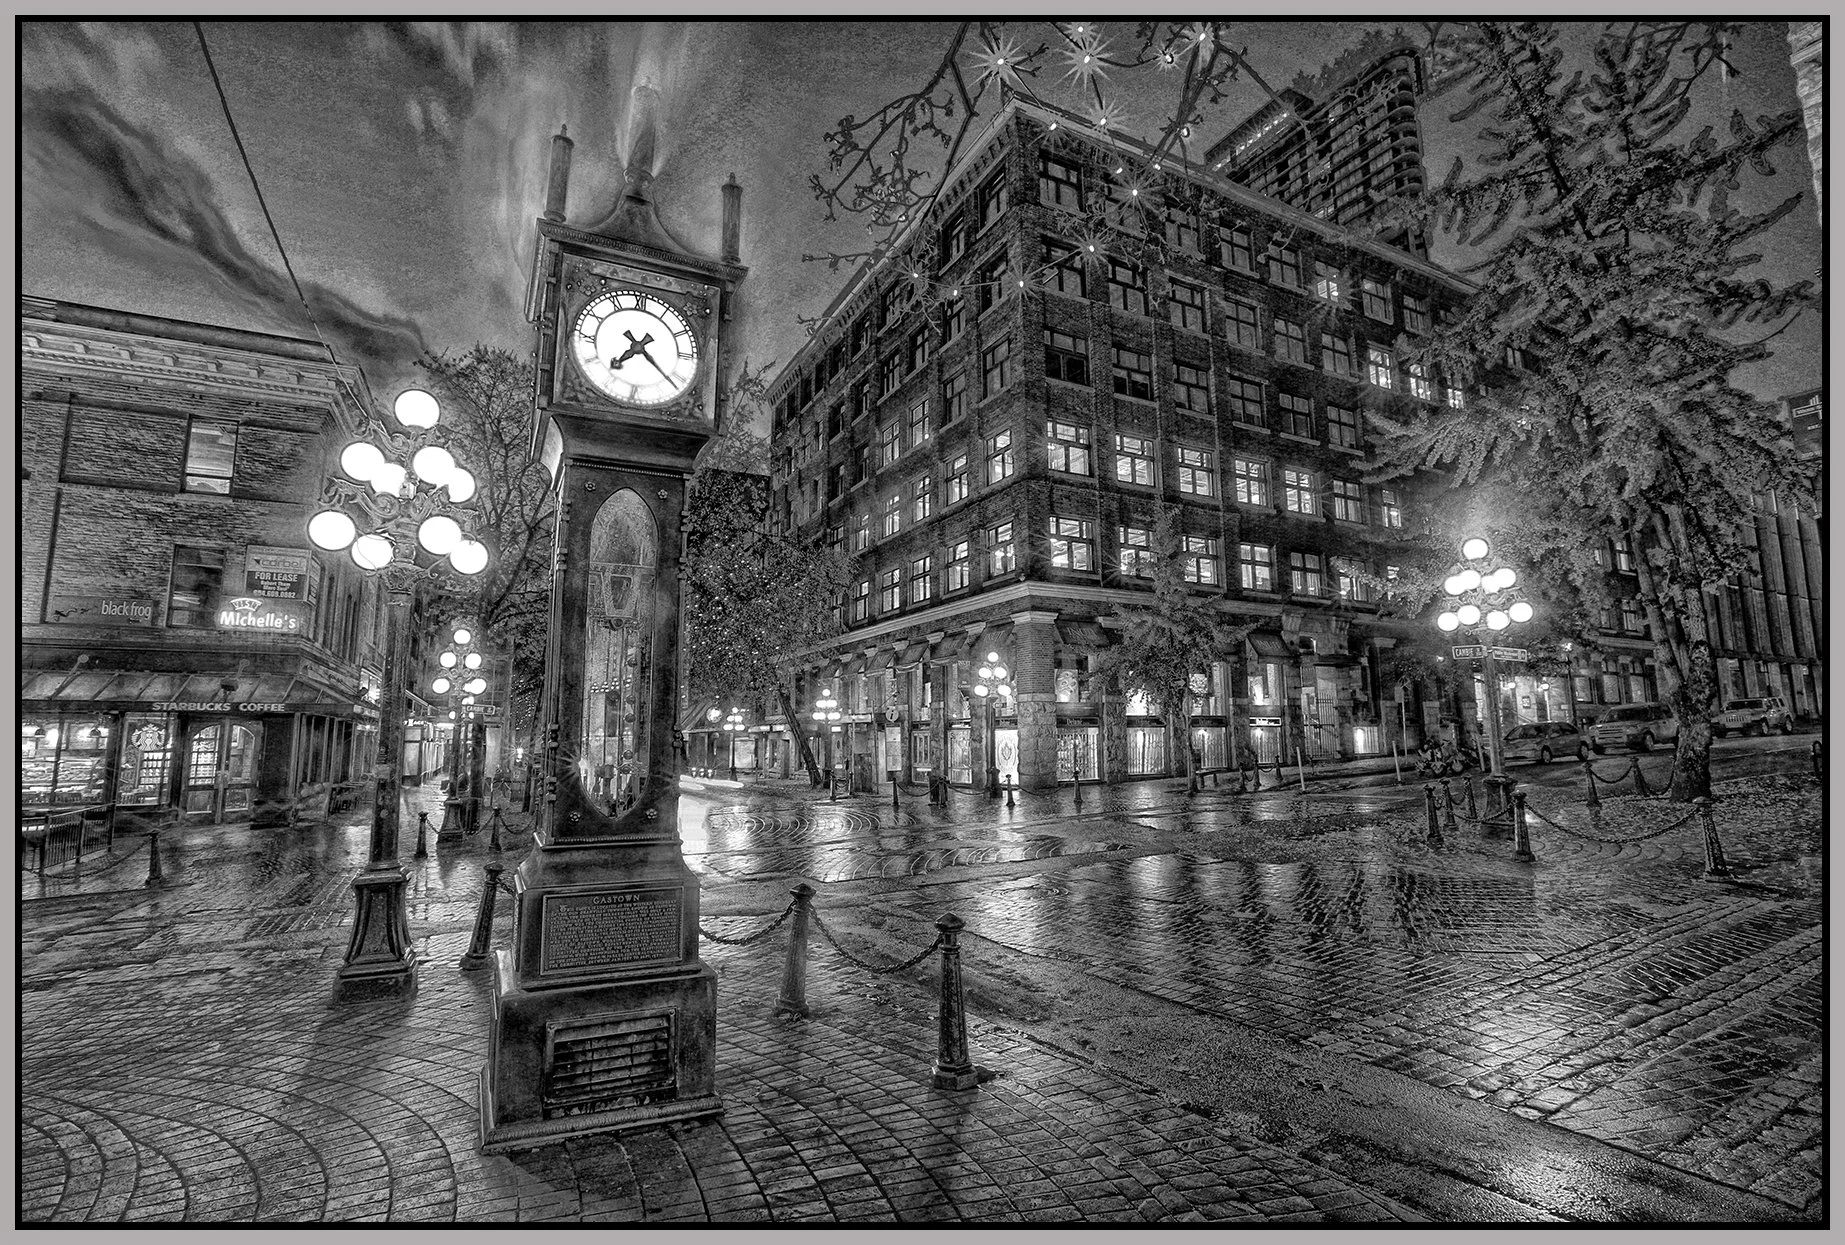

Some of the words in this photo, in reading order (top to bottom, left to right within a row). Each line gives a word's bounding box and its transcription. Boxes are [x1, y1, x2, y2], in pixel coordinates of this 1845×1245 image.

[254, 571, 271, 580] FOR
[273, 573, 298, 582] LEASE
[231, 599, 262, 609] VISIT
[101, 600, 128, 616] black
[130, 601, 152, 620] frog
[1455, 647, 1474, 657] CAMBIE
[152, 702, 231, 712] STARBUCKS
[238, 702, 286, 712] COFFEE
[593, 895, 640, 904] GASTOWN
